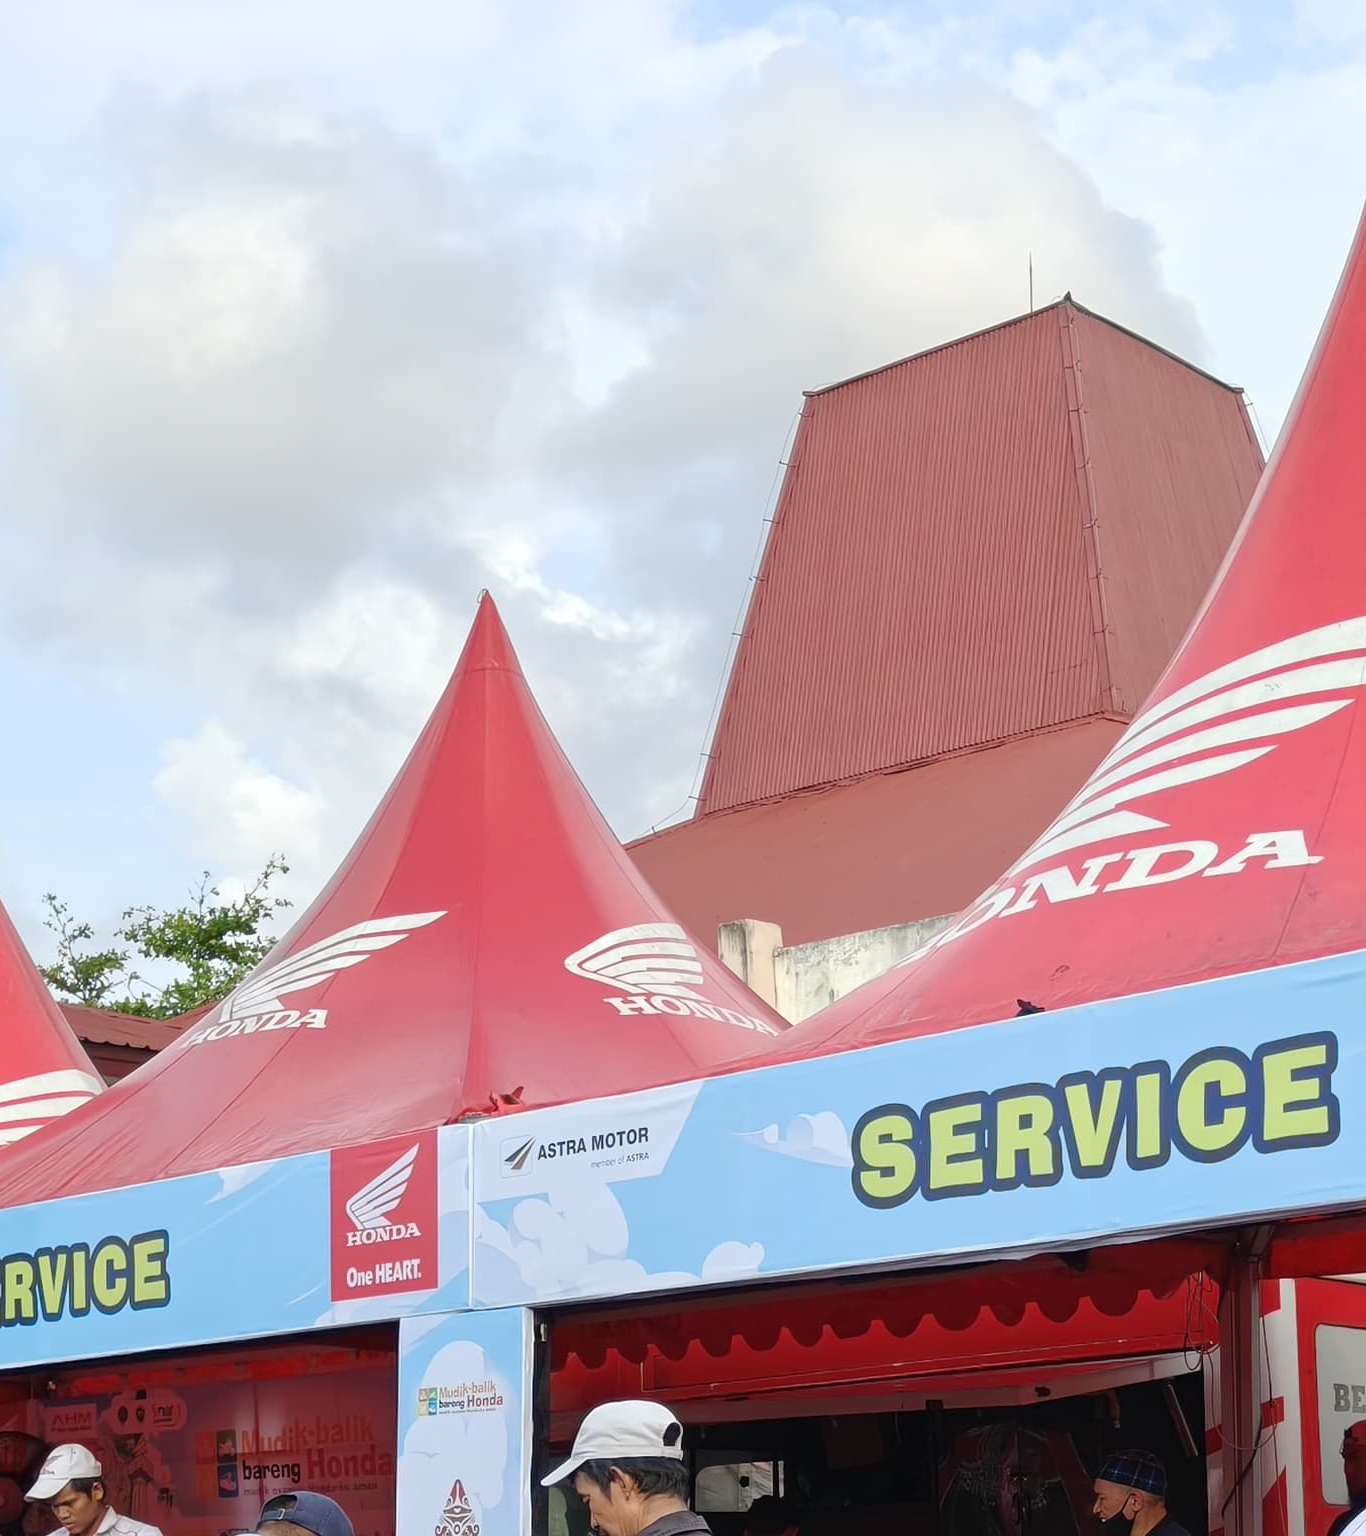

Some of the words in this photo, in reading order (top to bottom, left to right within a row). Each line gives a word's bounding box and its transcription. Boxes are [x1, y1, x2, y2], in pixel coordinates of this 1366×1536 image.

[181, 1008, 328, 1049] HONDA
[602, 996, 780, 1037] HONDA
[852, 1031, 1341, 1208] SERVICE
[537, 1137, 587, 1161] ASTRA
[591, 1127, 650, 1151] MOTOR
[626, 1152, 650, 1163] ASTRA
[346, 1222, 422, 1248] HONDA
[346, 1266, 374, 1289] One
[375, 1258, 423, 1284] HEART.
[438, 1380, 497, 1399] Mudik-balik
[438, 1400, 465, 1409] bareng
[467, 1393, 504, 1408] Honda
[241, 1414, 373, 1456] Mudik-balik
[242, 1460, 301, 1484] bareng
[306, 1447, 393, 1481] Honda
